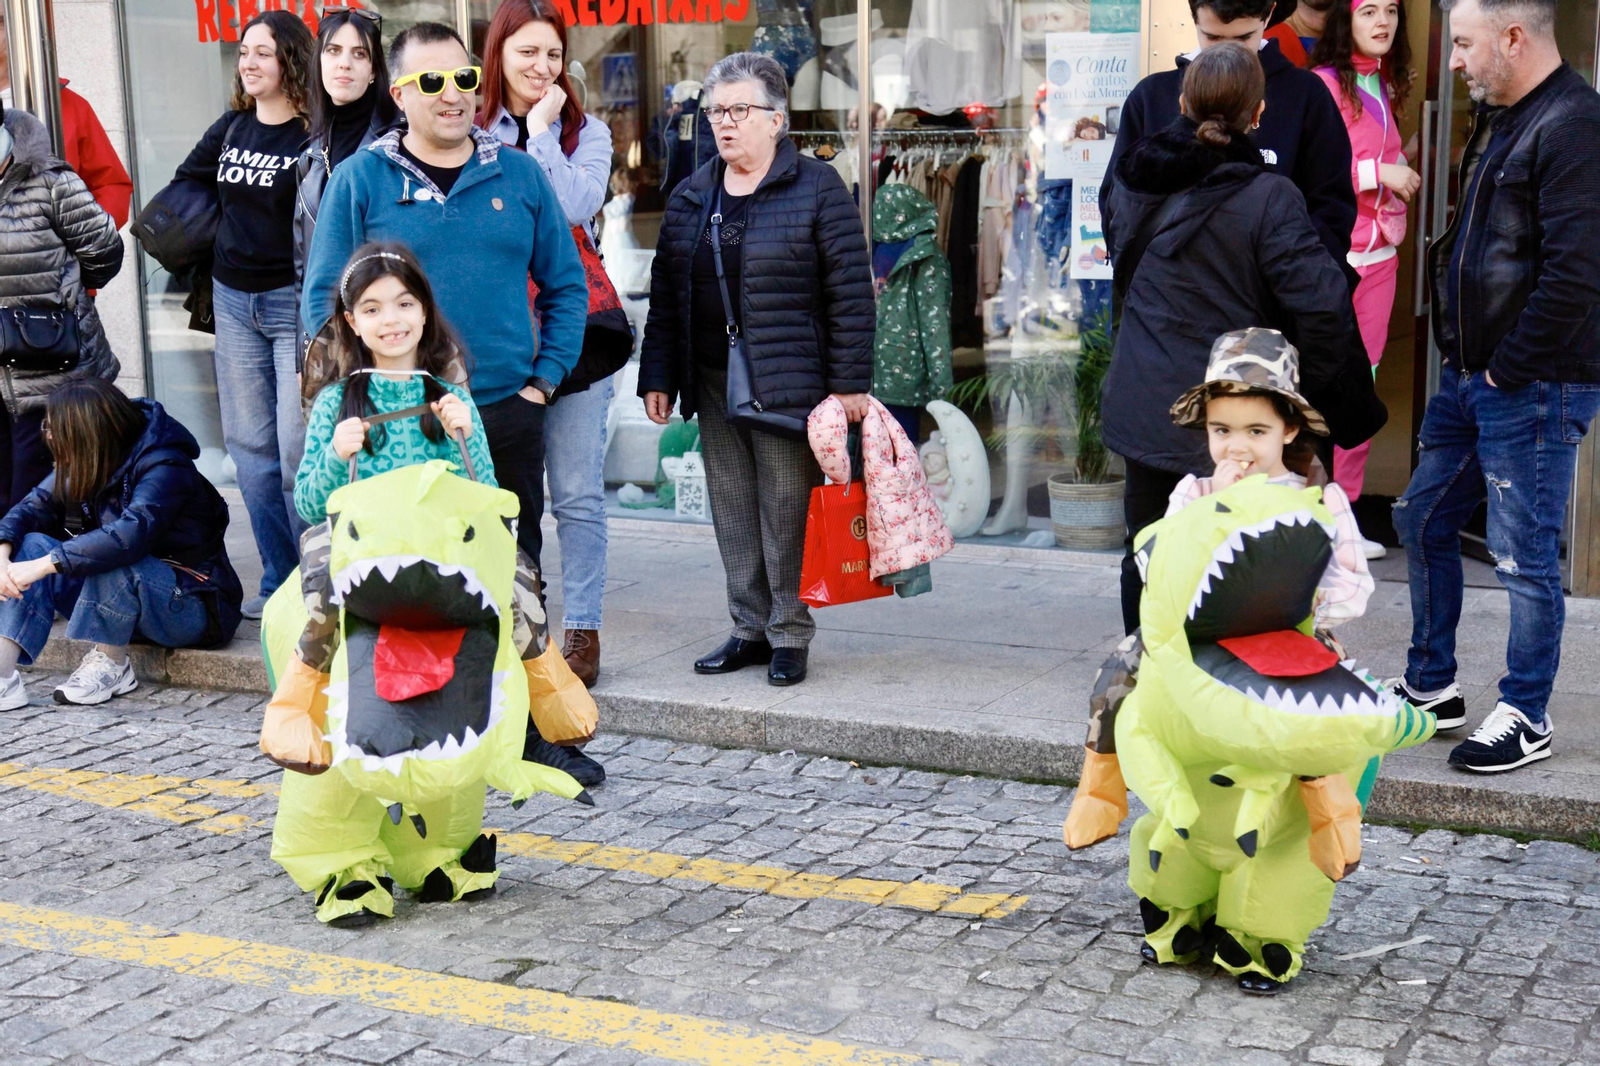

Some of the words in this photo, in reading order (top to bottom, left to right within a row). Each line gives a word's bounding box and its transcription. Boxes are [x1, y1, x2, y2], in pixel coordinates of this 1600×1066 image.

[1076, 55, 1127, 75] Conta
[1086, 74, 1127, 87] contos
[1053, 90, 1072, 100] con
[217, 163, 277, 188] LOVE
[1080, 186, 1100, 195] MEL
